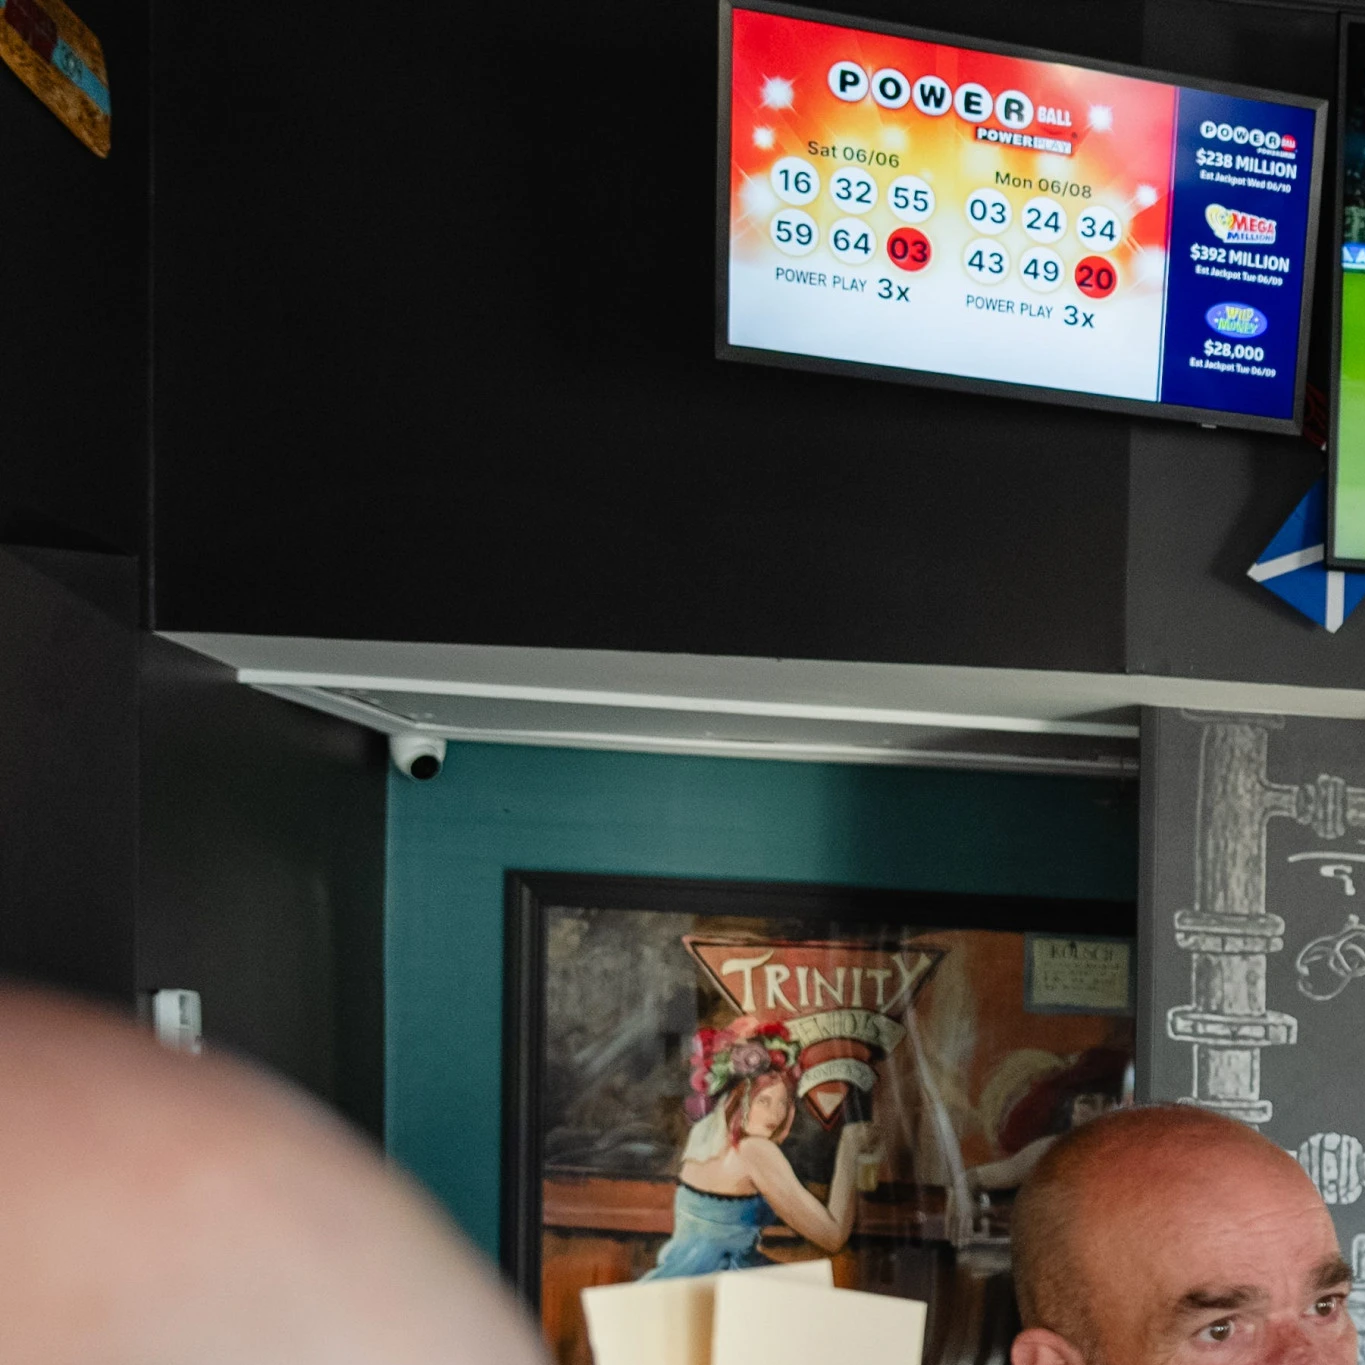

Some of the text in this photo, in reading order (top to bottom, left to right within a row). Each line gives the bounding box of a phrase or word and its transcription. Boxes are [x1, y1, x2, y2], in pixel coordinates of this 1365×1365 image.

[838, 69, 1026, 123] POWER
[808, 141, 900, 168] Sat 06/06
[1196, 147, 1298, 180] $238 MILLION
[779, 169, 928, 212] 16 32 55
[995, 171, 1092, 199] Mon 06/08
[1200, 170, 1214, 181] Est
[1215, 172, 1246, 186] Jackpot
[1247, 177, 1265, 189] Wed
[970, 199, 1116, 242] 03 24 34
[1231, 212, 1275, 233] MEGA
[776, 220, 928, 263] 59 64 03
[1190, 242, 1290, 273] $392 MILLION
[776, 267, 911, 302] POWER PLAY 3x
[968, 250, 1113, 290] 43 49 20
[1195, 264, 1210, 275] Est
[1210, 266, 1241, 281] Jackpot
[1242, 271, 1257, 282] Tue
[966, 294, 1096, 329] POWER PLAY 3x
[1189, 357, 1203, 368] Est
[1204, 359, 1235, 373] Jackpot
[1236, 363, 1251, 374] Tue
[1204, 338, 1265, 361] $28,000
[721, 948, 931, 1014] TRINITY
